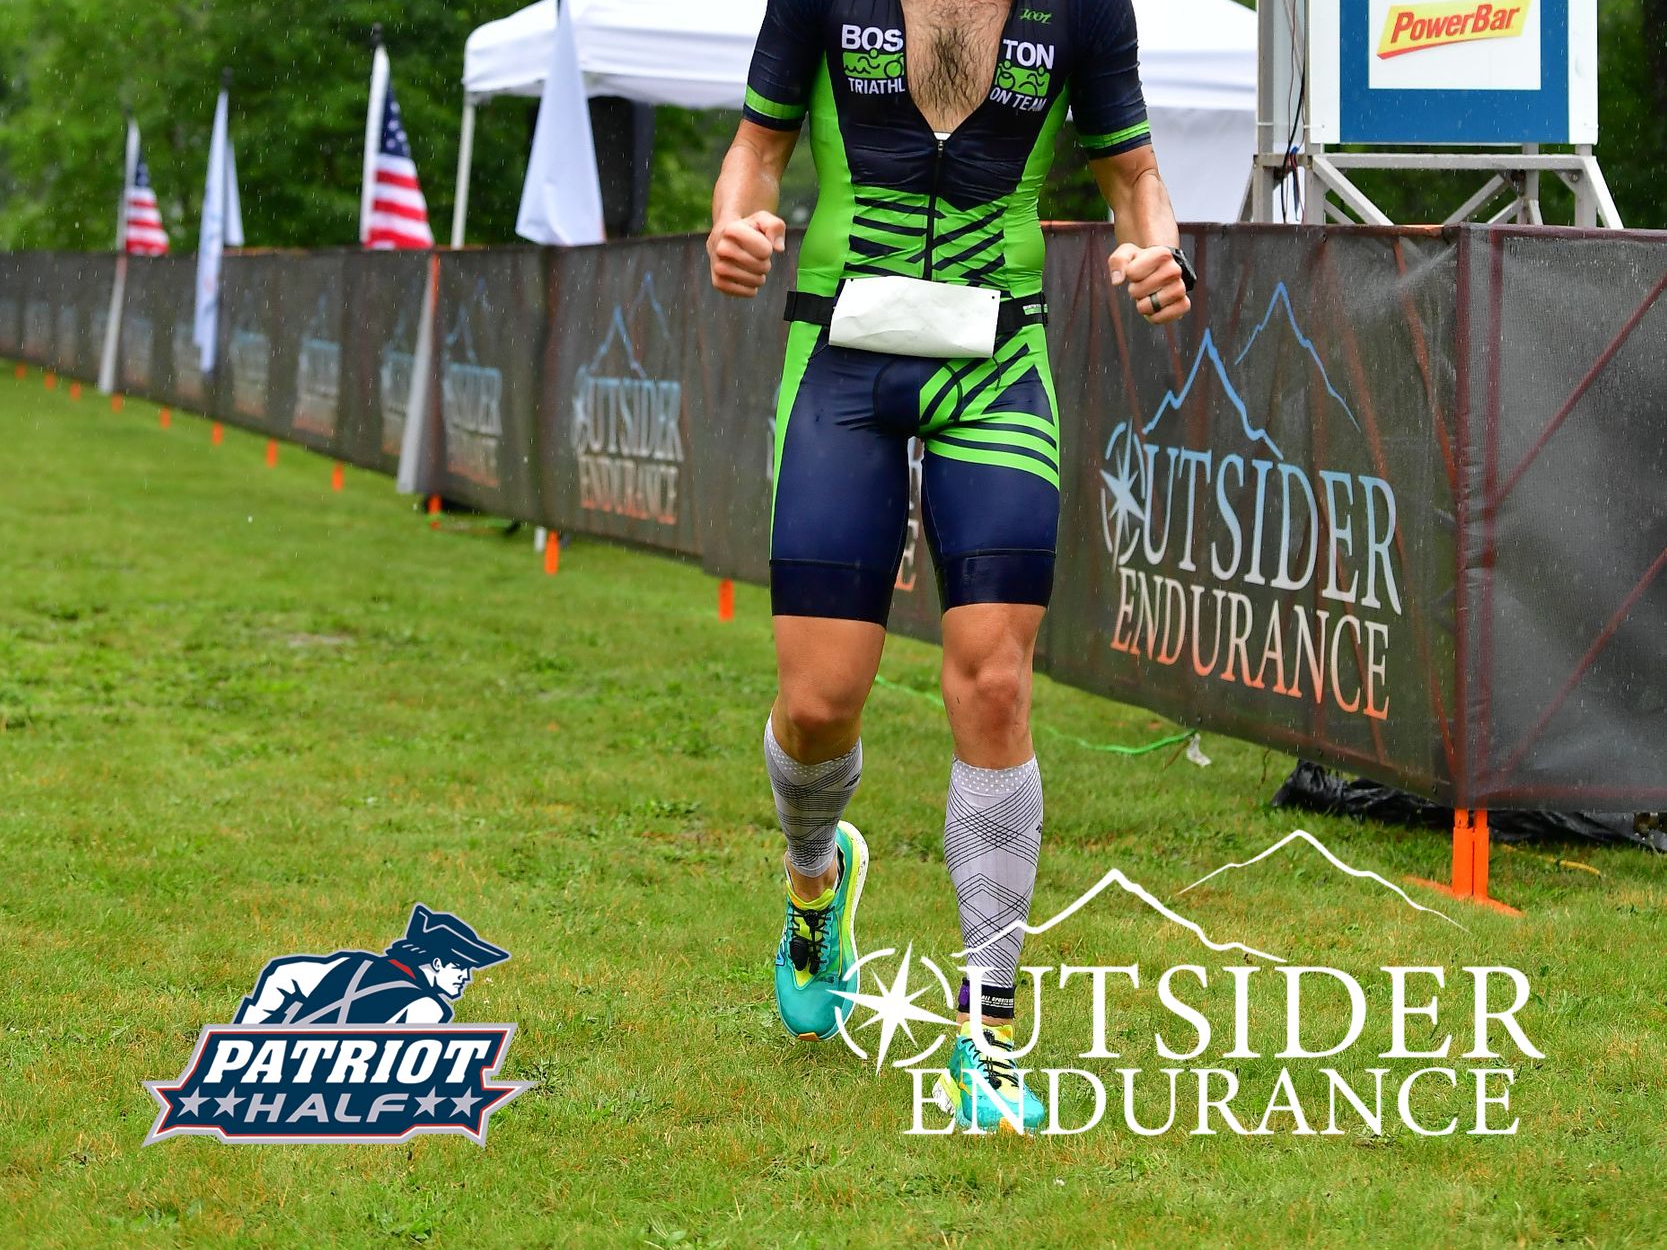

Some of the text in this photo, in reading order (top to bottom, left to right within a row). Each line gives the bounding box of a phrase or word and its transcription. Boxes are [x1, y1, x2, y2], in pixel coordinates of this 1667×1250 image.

[1390, 3, 1521, 44] PowerBar
[841, 24, 1055, 70] BOS TON
[989, 87, 1010, 105] ON
[1013, 93, 1048, 113] TEAM
[1110, 566, 1390, 721] ENDURANCE
